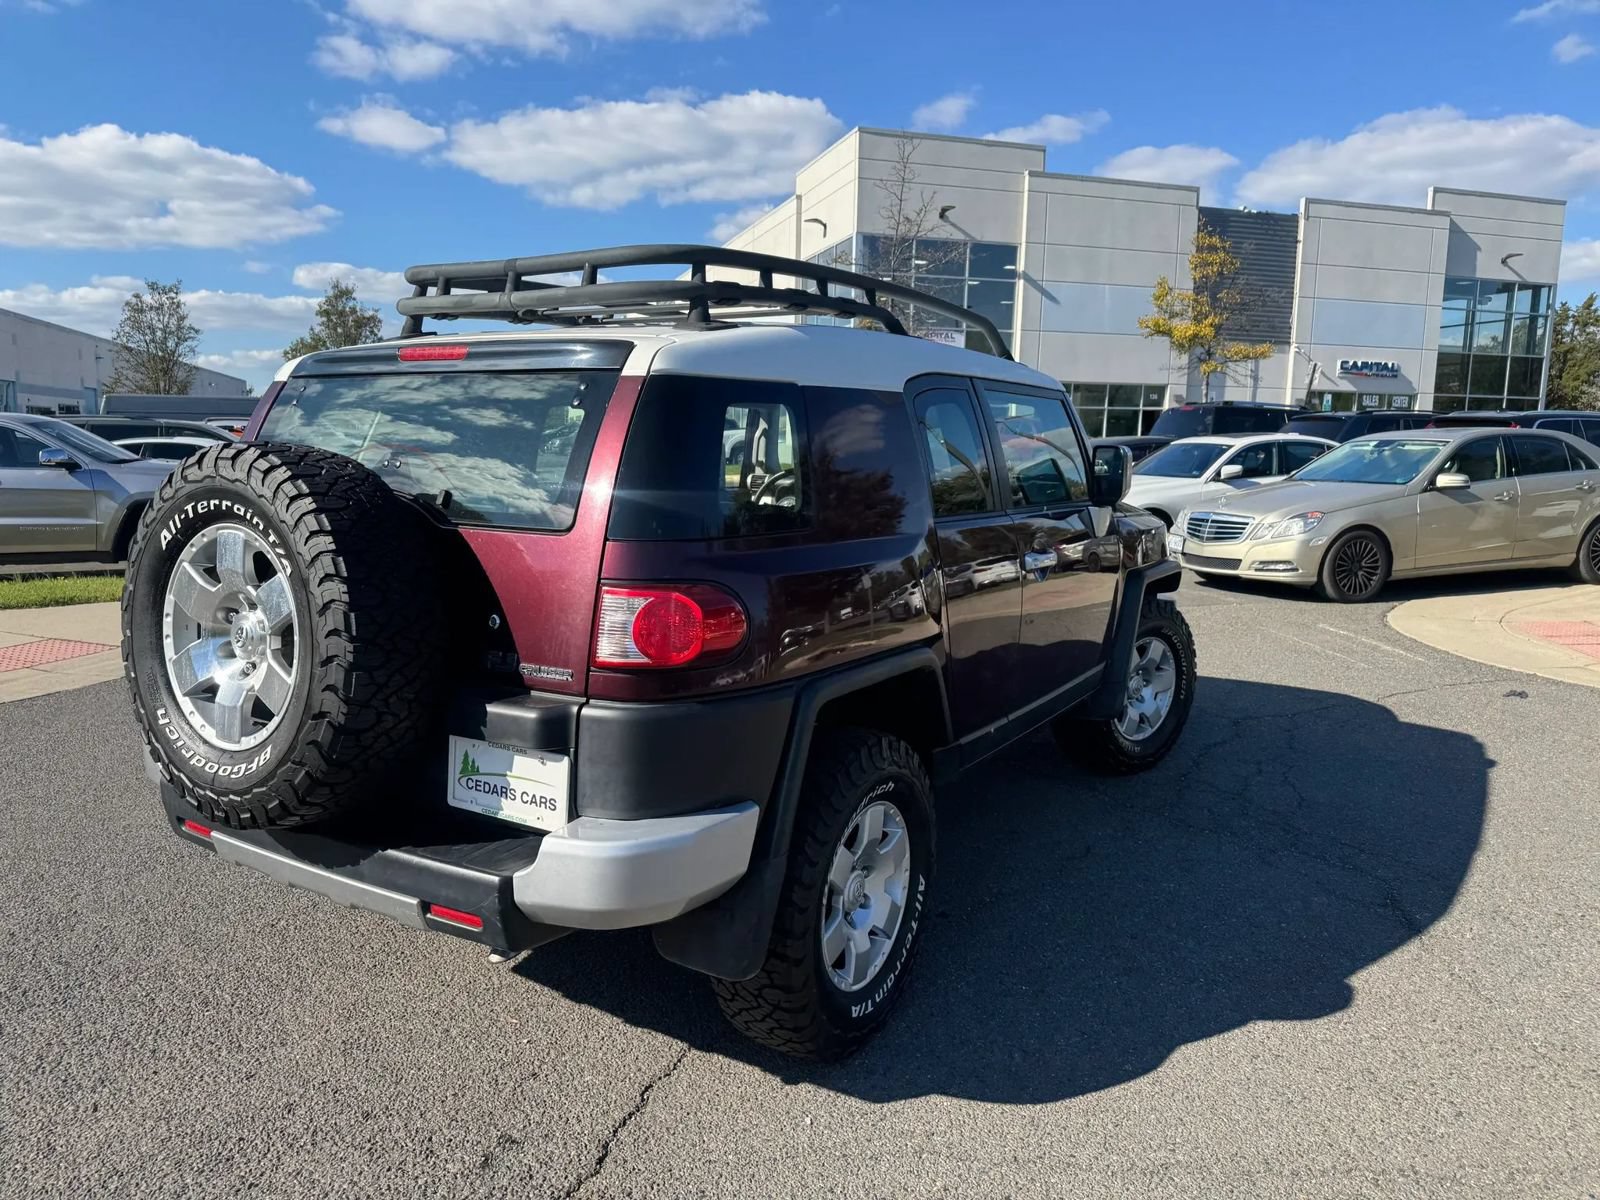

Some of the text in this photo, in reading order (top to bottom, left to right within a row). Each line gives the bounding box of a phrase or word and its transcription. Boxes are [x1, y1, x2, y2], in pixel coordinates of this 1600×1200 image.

[1340, 360, 1398, 372] CAPITAL
[1362, 395, 1408, 408] SALES CENTER
[160, 499, 292, 577] All-Terrain T/A
[157, 707, 272, 778] BFGoodrich
[487, 741, 528, 755] CEDARS CARS
[465, 777, 557, 812] CEDARS CARS
[851, 874, 926, 1018] All-Terrain T/A
